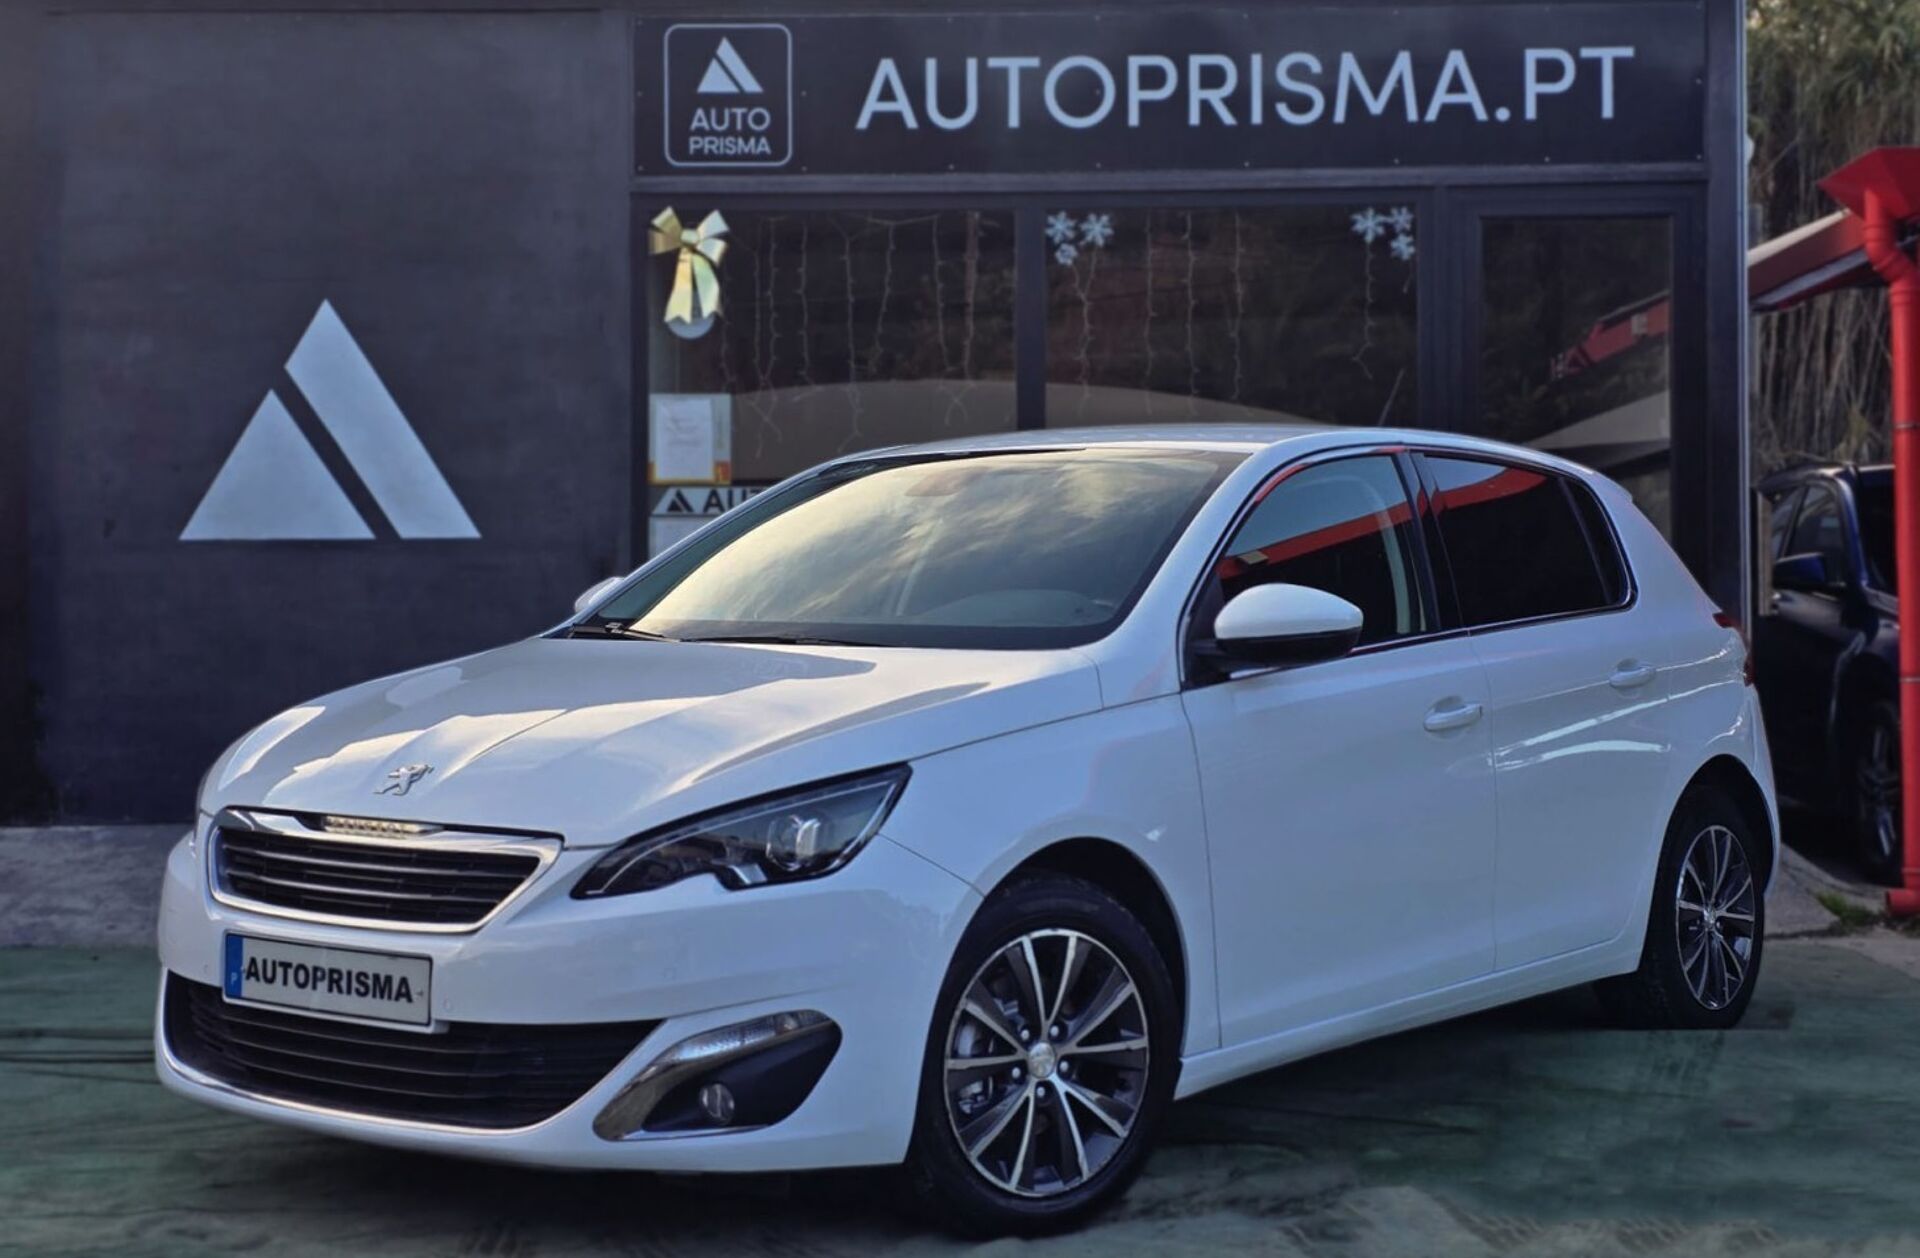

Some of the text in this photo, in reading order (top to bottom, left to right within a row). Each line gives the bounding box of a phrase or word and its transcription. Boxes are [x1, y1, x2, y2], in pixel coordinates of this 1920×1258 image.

[856, 46, 1635, 130] AUTOPRISMA.PT
[691, 107, 771, 131] AUTO
[689, 136, 771, 155] PRISMA
[245, 956, 413, 1003] AUTOPRISMA
